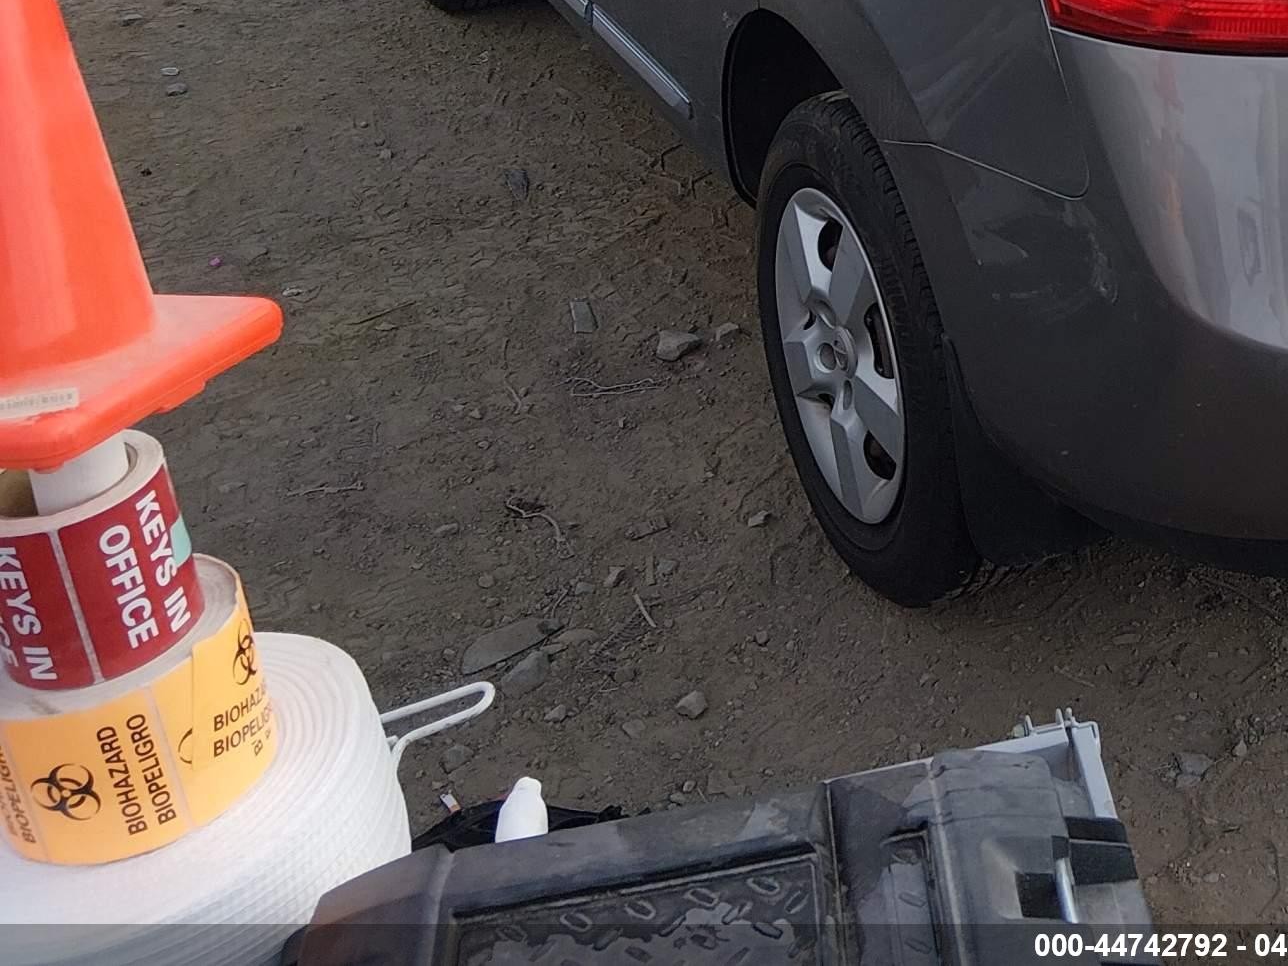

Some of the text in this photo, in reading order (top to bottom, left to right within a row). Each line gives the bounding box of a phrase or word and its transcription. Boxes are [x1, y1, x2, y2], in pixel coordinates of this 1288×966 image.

[99, 524, 159, 650] OFFICE
[135, 490, 192, 634] KEYS IN
[22, 646, 58, 680] IN
[96, 726, 148, 836] BIOHAZARD
[126, 714, 177, 825] BIOPELIGRO
